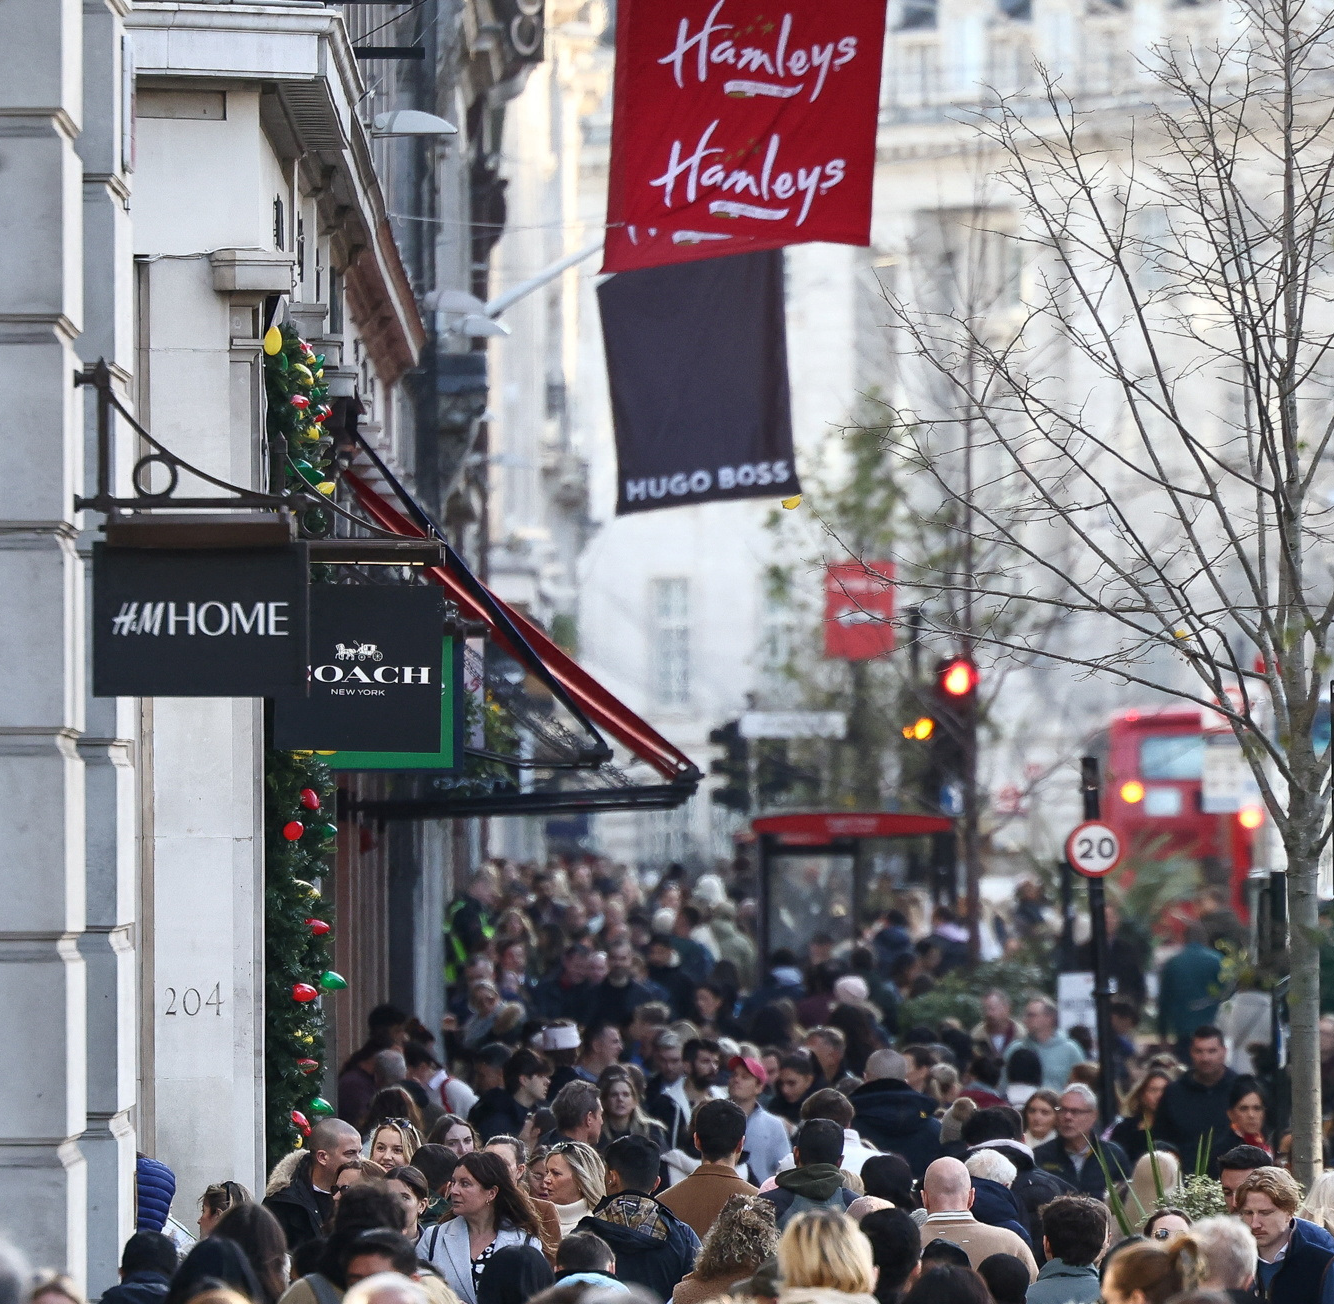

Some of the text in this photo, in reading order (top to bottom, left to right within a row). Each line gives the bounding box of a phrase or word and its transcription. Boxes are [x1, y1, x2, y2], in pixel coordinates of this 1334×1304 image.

[657, 0, 858, 103] Hamleys
[649, 119, 846, 227] Hamleys
[625, 459, 790, 502] HUGO BOSS
[307, 665, 431, 685] OACH
[330, 688, 385, 696] NEW YORK
[1078, 837, 1115, 859] 20
[165, 981, 225, 1016] 204
